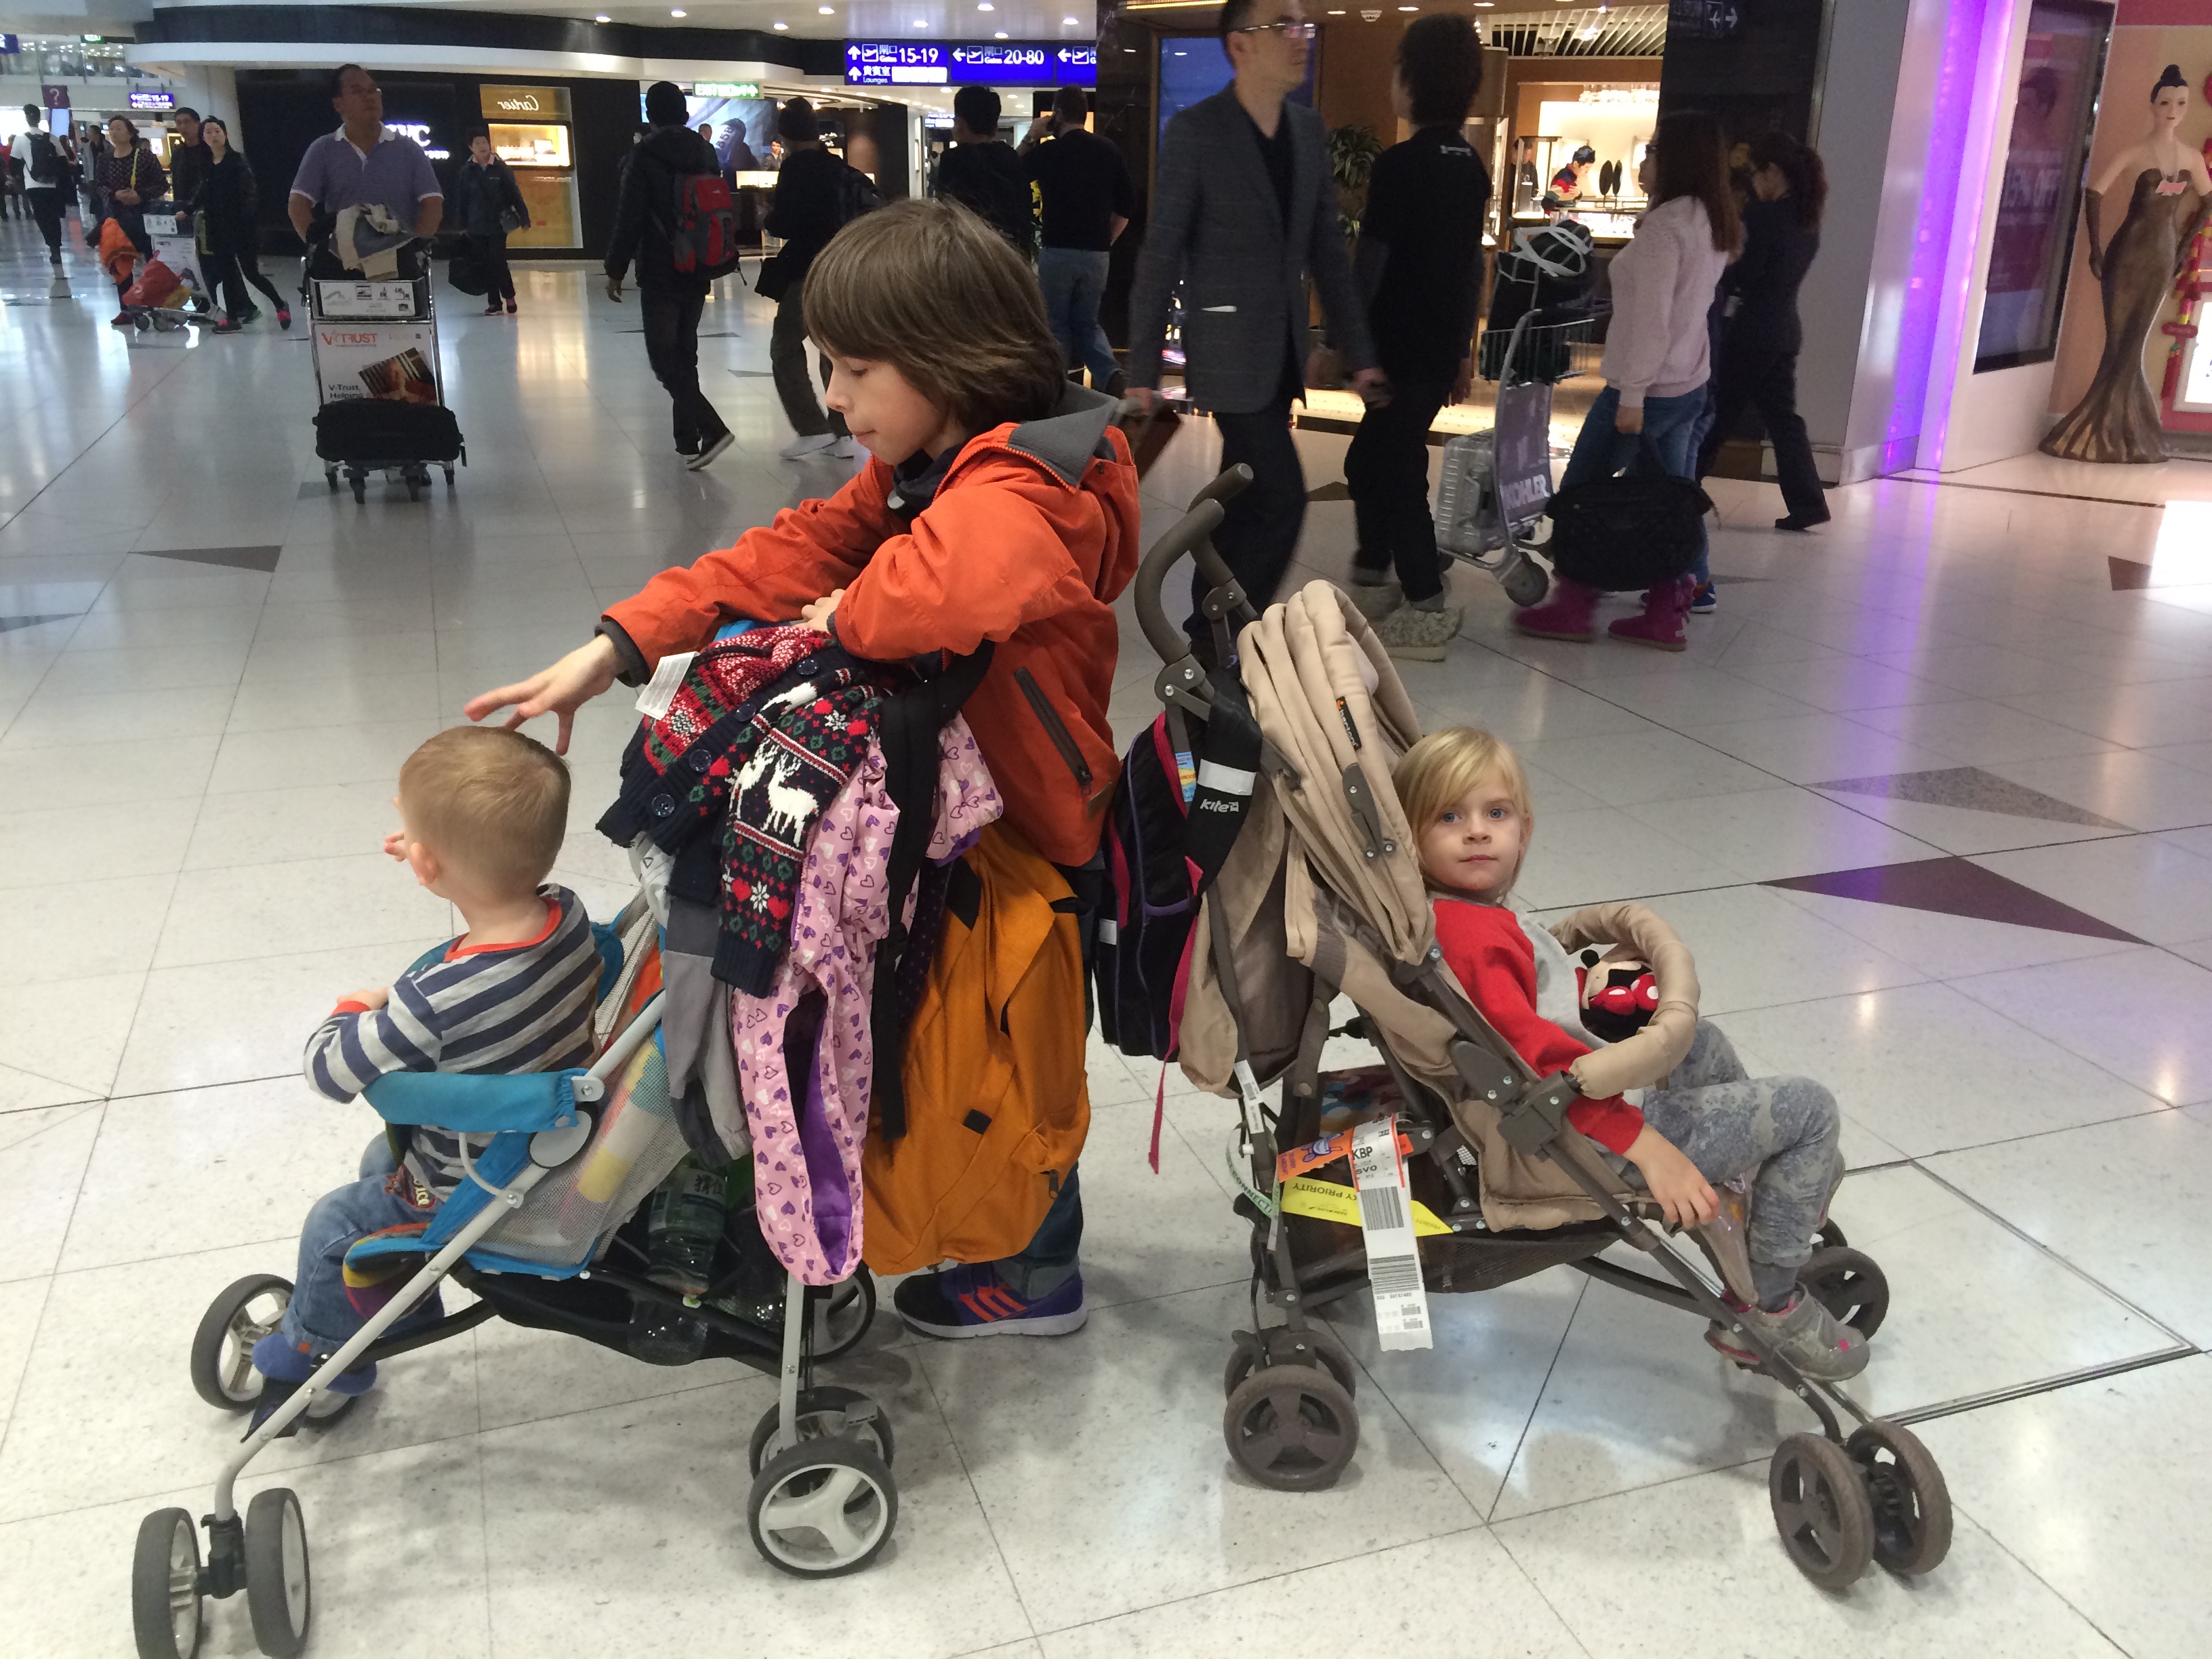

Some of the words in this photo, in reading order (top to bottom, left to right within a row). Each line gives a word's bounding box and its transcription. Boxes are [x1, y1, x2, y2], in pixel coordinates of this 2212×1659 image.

[899, 47, 939, 63] 15-19
[1004, 49, 1044, 64] 20-80
[1200, 798, 1229, 813] kite
[1351, 1145, 1373, 1160] KBP
[1356, 1164, 1377, 1175] SVO
[1292, 1183, 1343, 1197] PRIORITY
